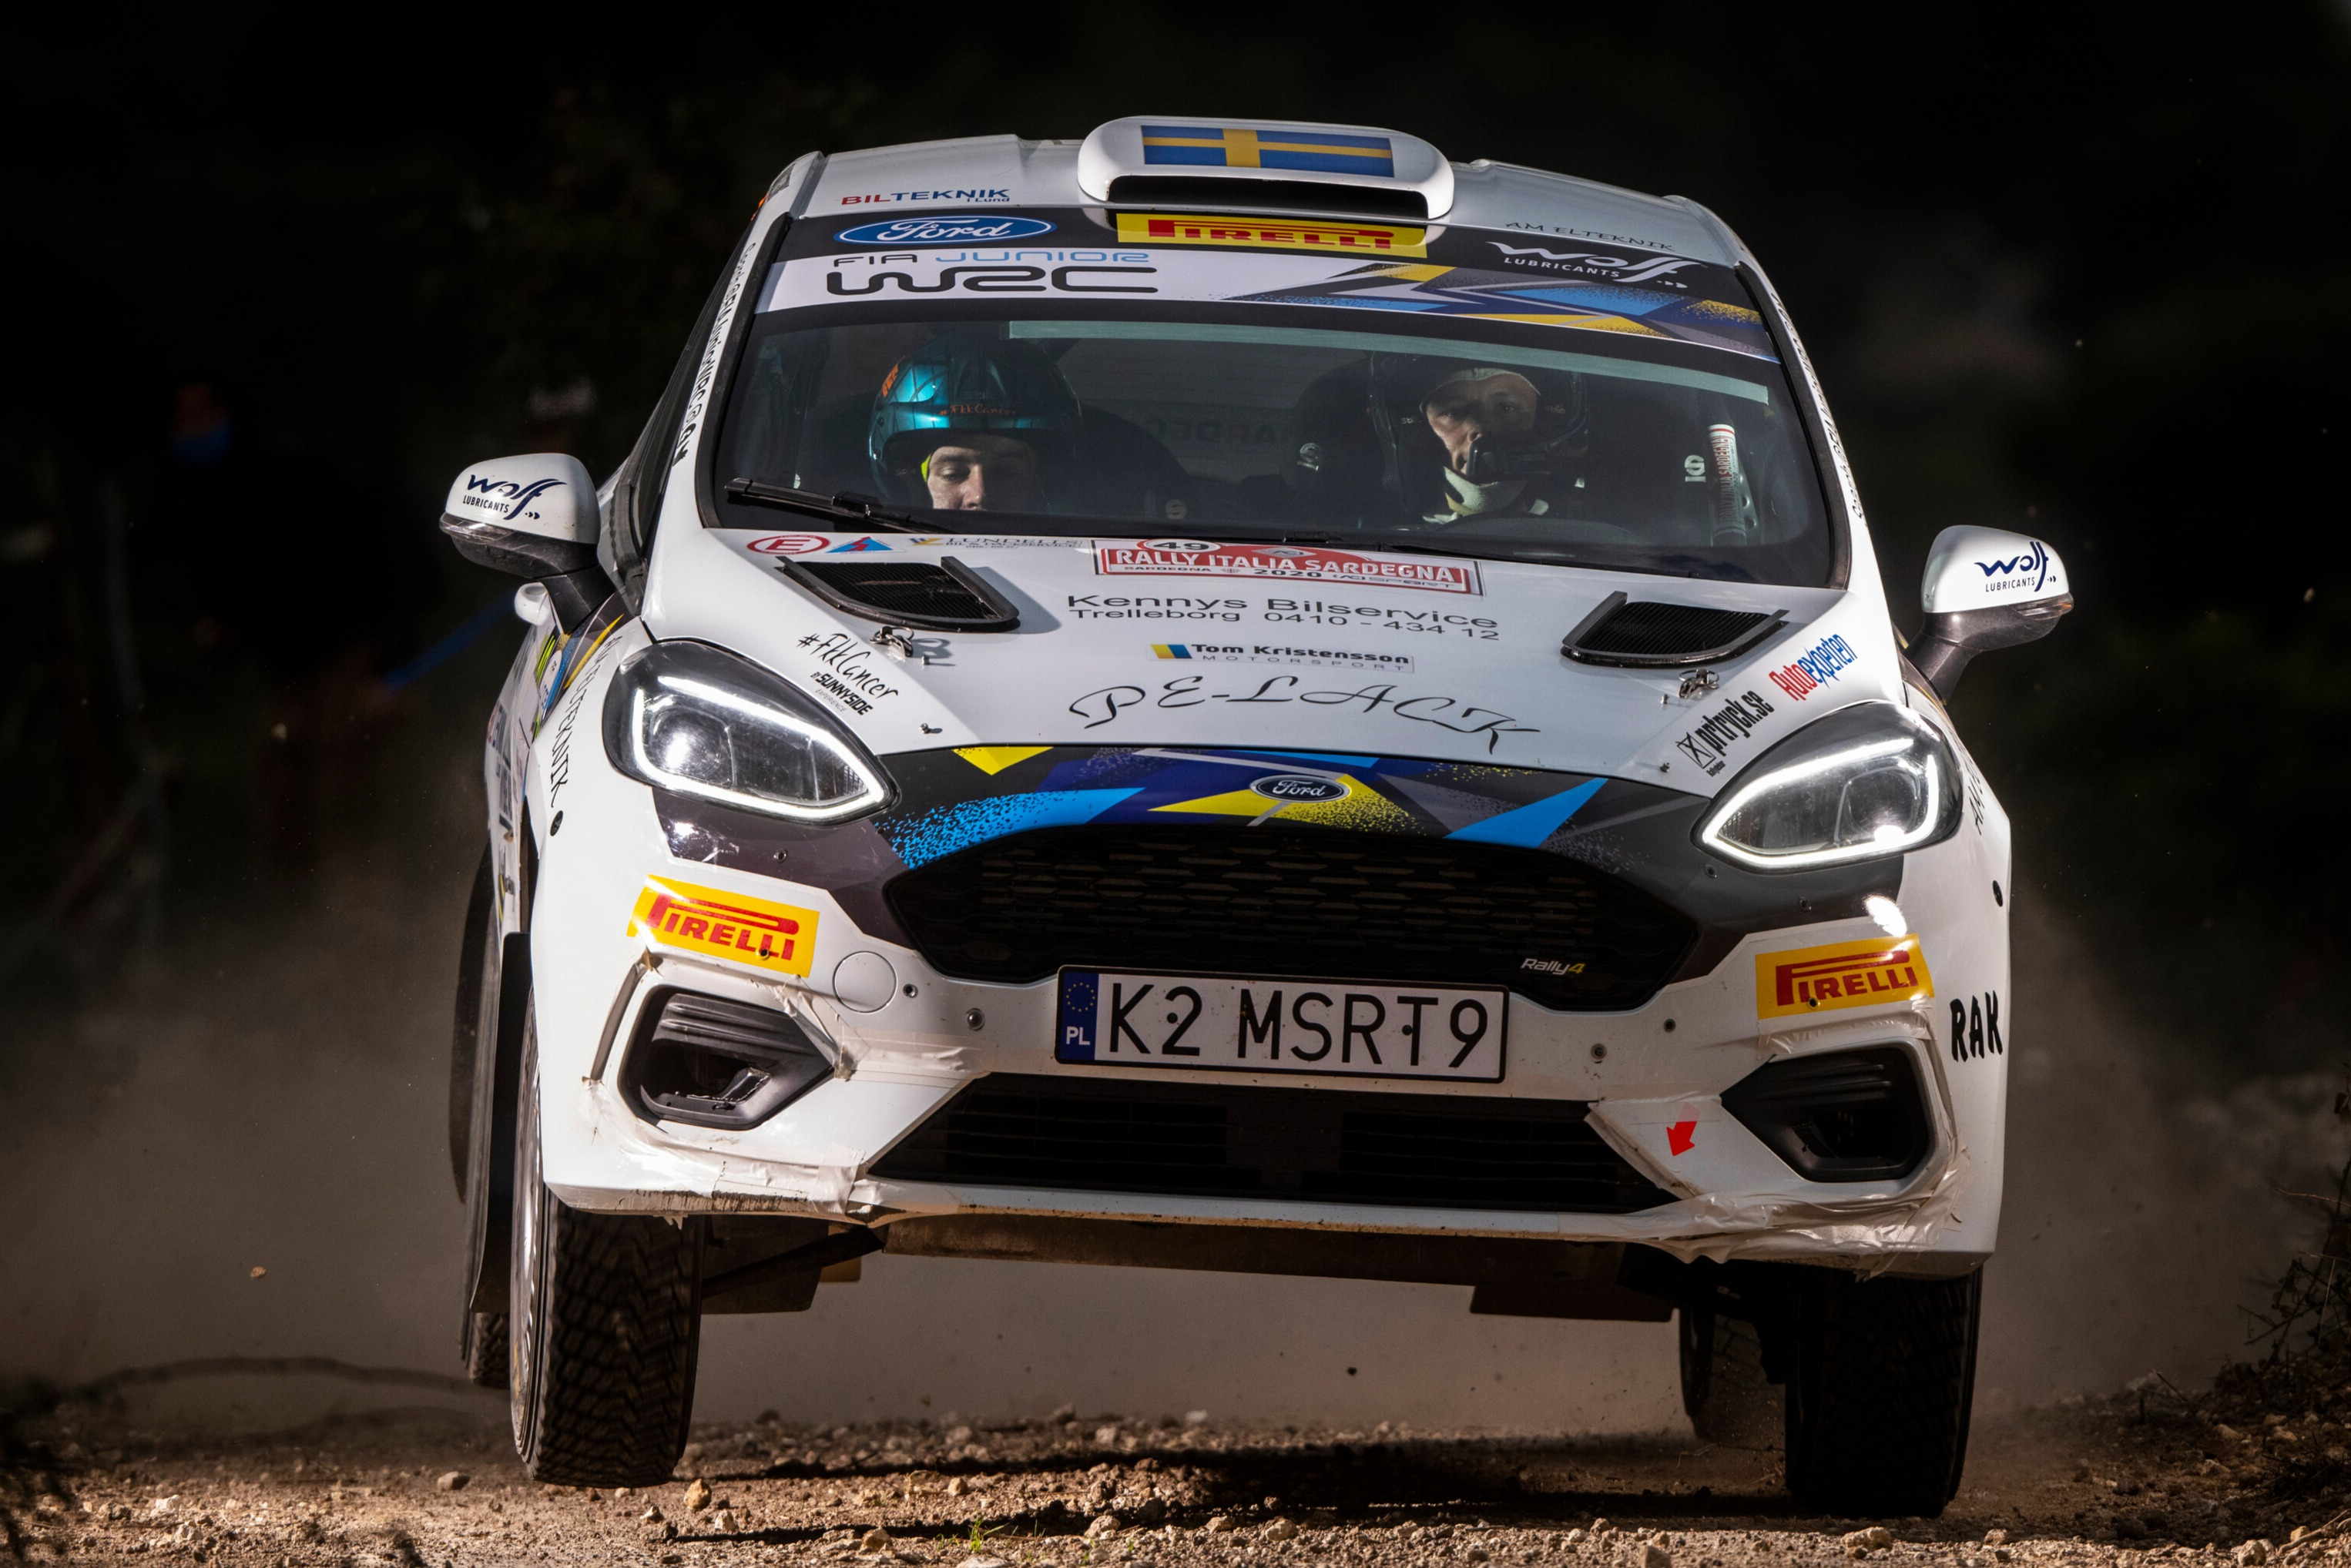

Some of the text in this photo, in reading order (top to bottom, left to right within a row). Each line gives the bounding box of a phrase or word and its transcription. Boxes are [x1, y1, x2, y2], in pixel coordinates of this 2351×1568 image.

[841, 188, 1010, 205] BILTEKNIK
[877, 217, 1011, 242] Ford
[1148, 219, 1395, 249] PIRELLI
[833, 250, 1150, 267] FIA JUNIOR
[1504, 256, 1620, 277] LUBRICANTS
[827, 266, 1159, 296] WRC
[1712, 437, 1731, 477] SARDEGNA
[462, 495, 509, 513] LUBRICANTS
[1153, 541, 1209, 551] 49
[1115, 550, 1455, 582] RALLY ITALIA SARDEGNA
[1254, 569, 1322, 578] 2020
[1986, 577, 2035, 592] LUBRICANTS
[1068, 595, 1497, 628] Kennys Bilservice
[1069, 609, 1240, 622] Trelleborg
[1264, 611, 1347, 625] 0410
[1383, 621, 1445, 634] 434
[1461, 628, 1499, 640] 12
[1191, 644, 1409, 663] Tom Kristensson
[1203, 655, 1404, 670] MOTORSPORT
[1769, 634, 1857, 701] Autoexperten
[815, 689, 847, 713] EXPERIENCE
[816, 673, 873, 715] SUNNYSIDE
[1272, 779, 1325, 798] Ford
[646, 893, 800, 960] PIRELLI
[1520, 957, 1586, 975] Rally4
[1775, 950, 1919, 1007] PIRELLI
[1065, 1027, 1091, 1047] PL
[1109, 983, 1488, 1069] K2 MSRT9
[1950, 990, 2003, 1062] RAK
